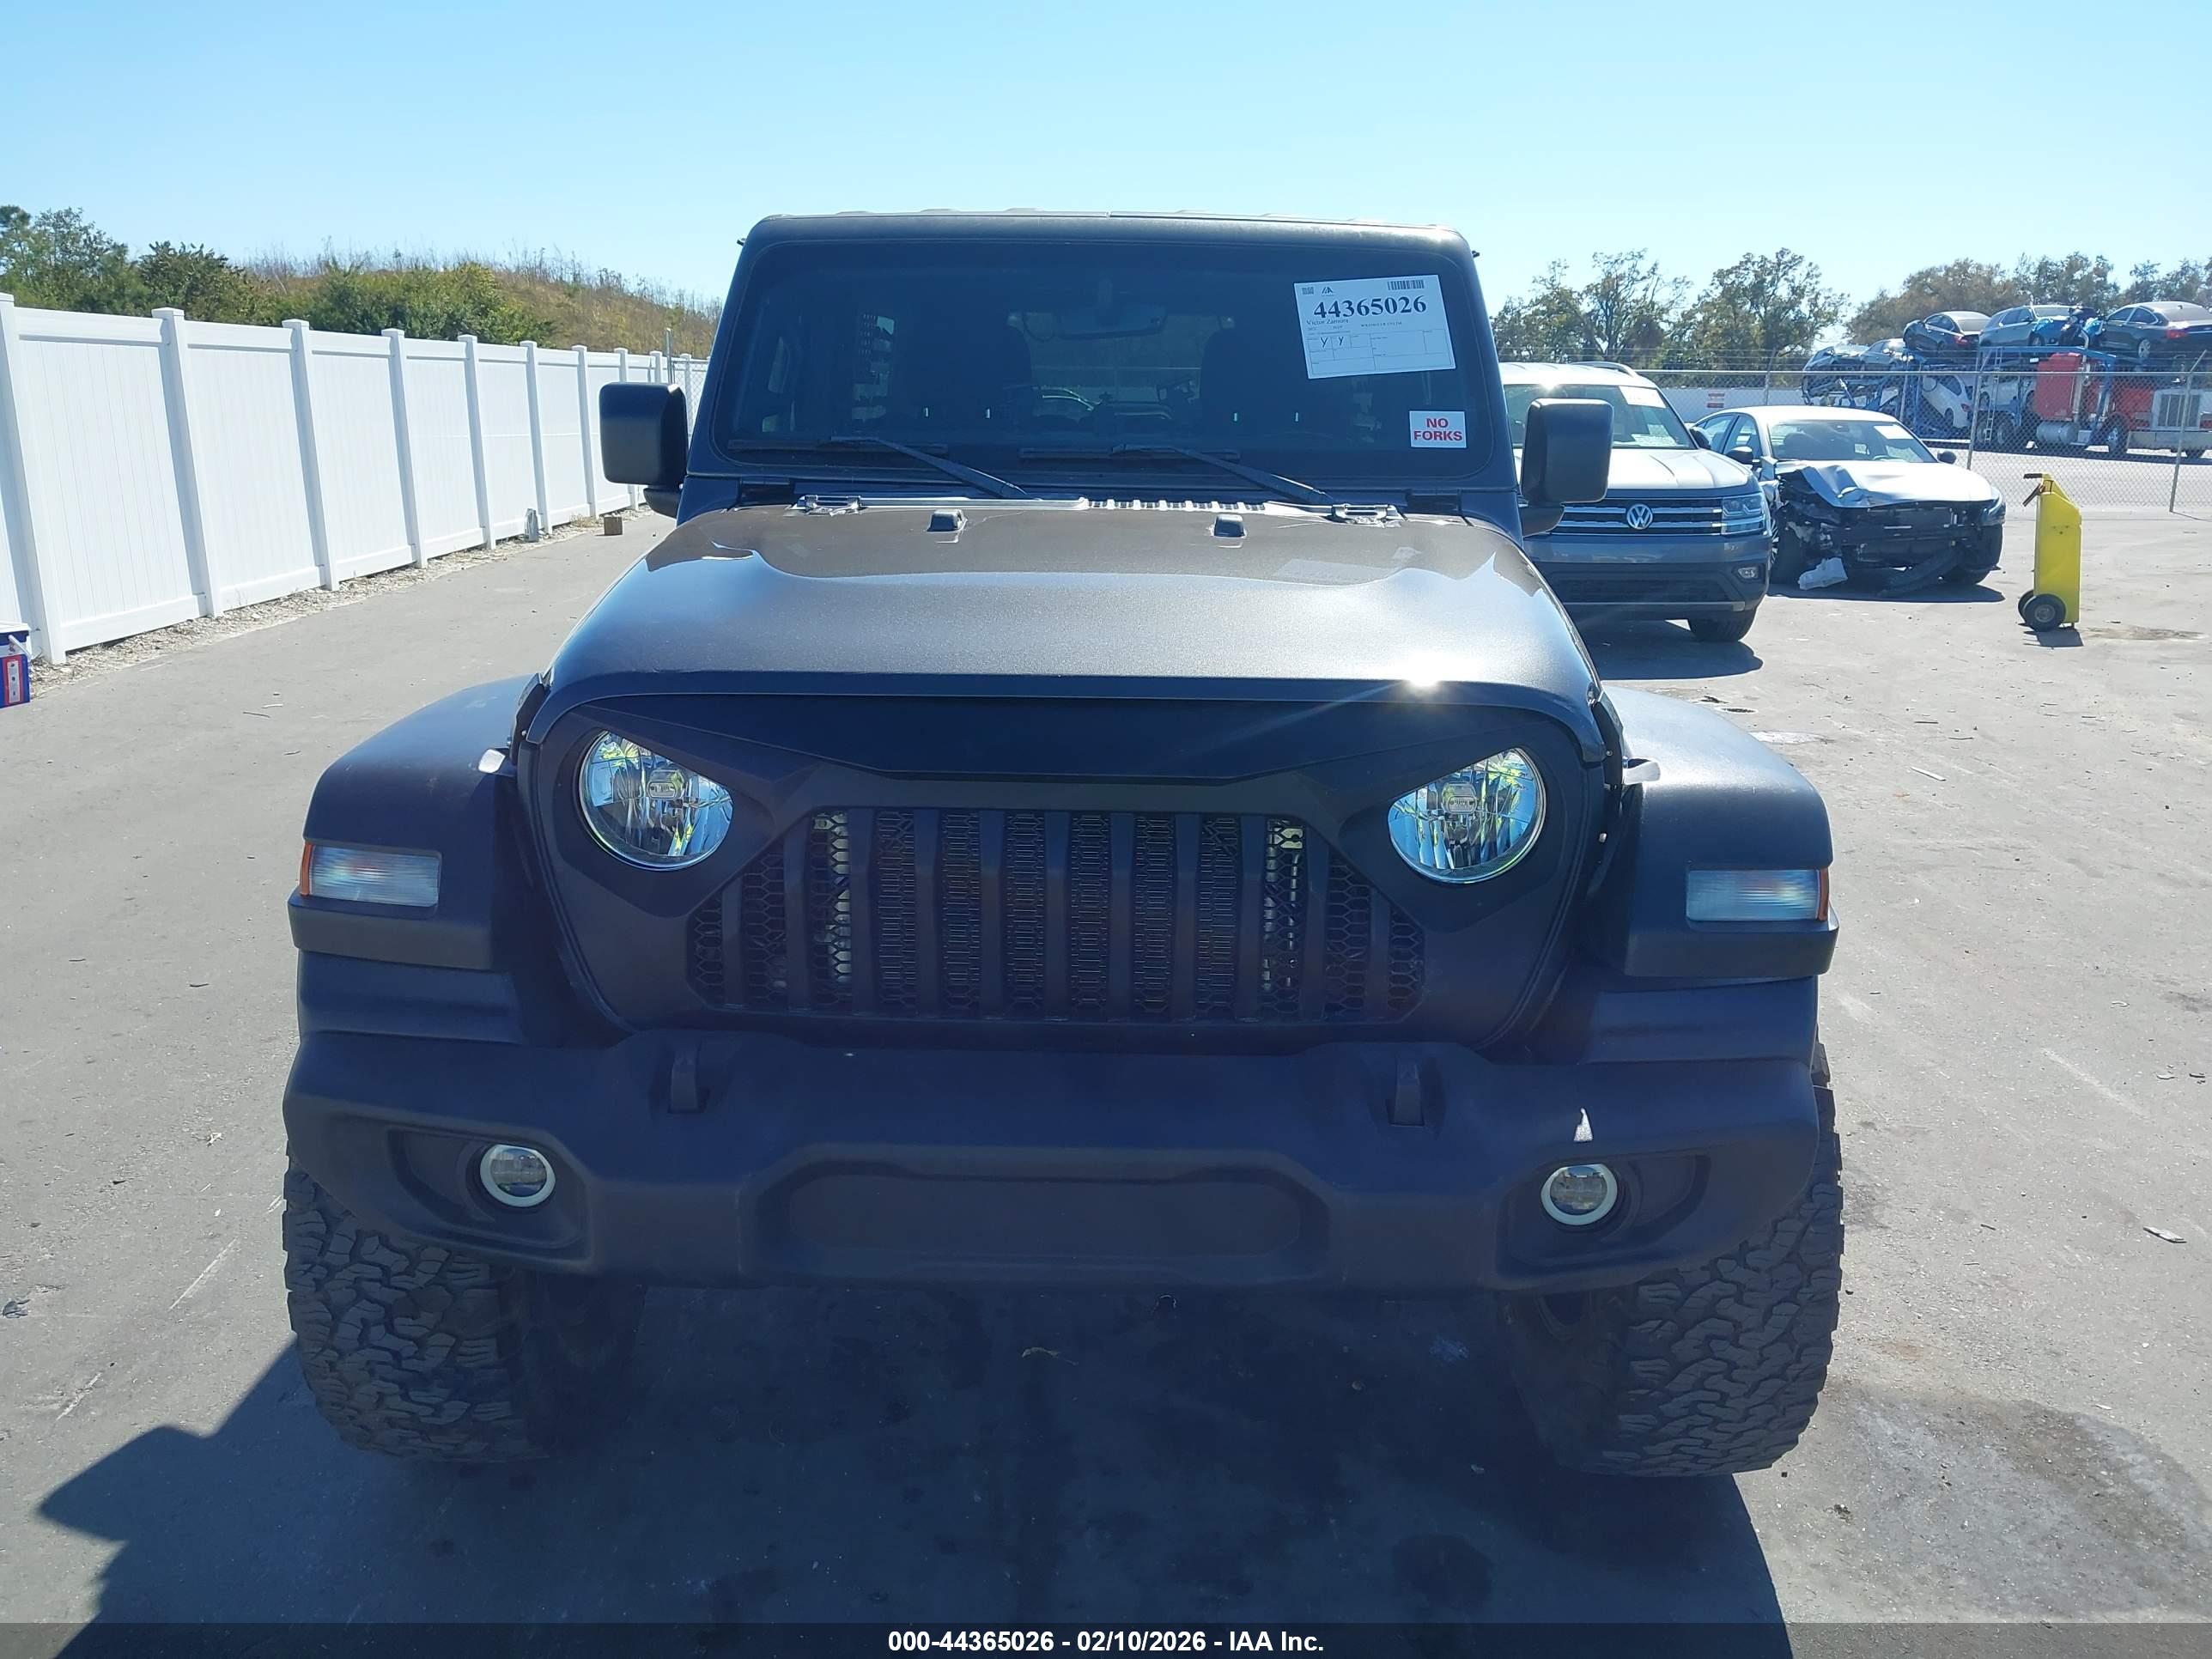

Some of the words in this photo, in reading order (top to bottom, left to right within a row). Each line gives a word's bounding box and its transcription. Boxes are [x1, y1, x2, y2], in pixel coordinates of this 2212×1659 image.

[1314, 295, 1426, 318] 44365026
[1426, 418, 1449, 428] NO
[1413, 430, 1463, 441] FORKS
